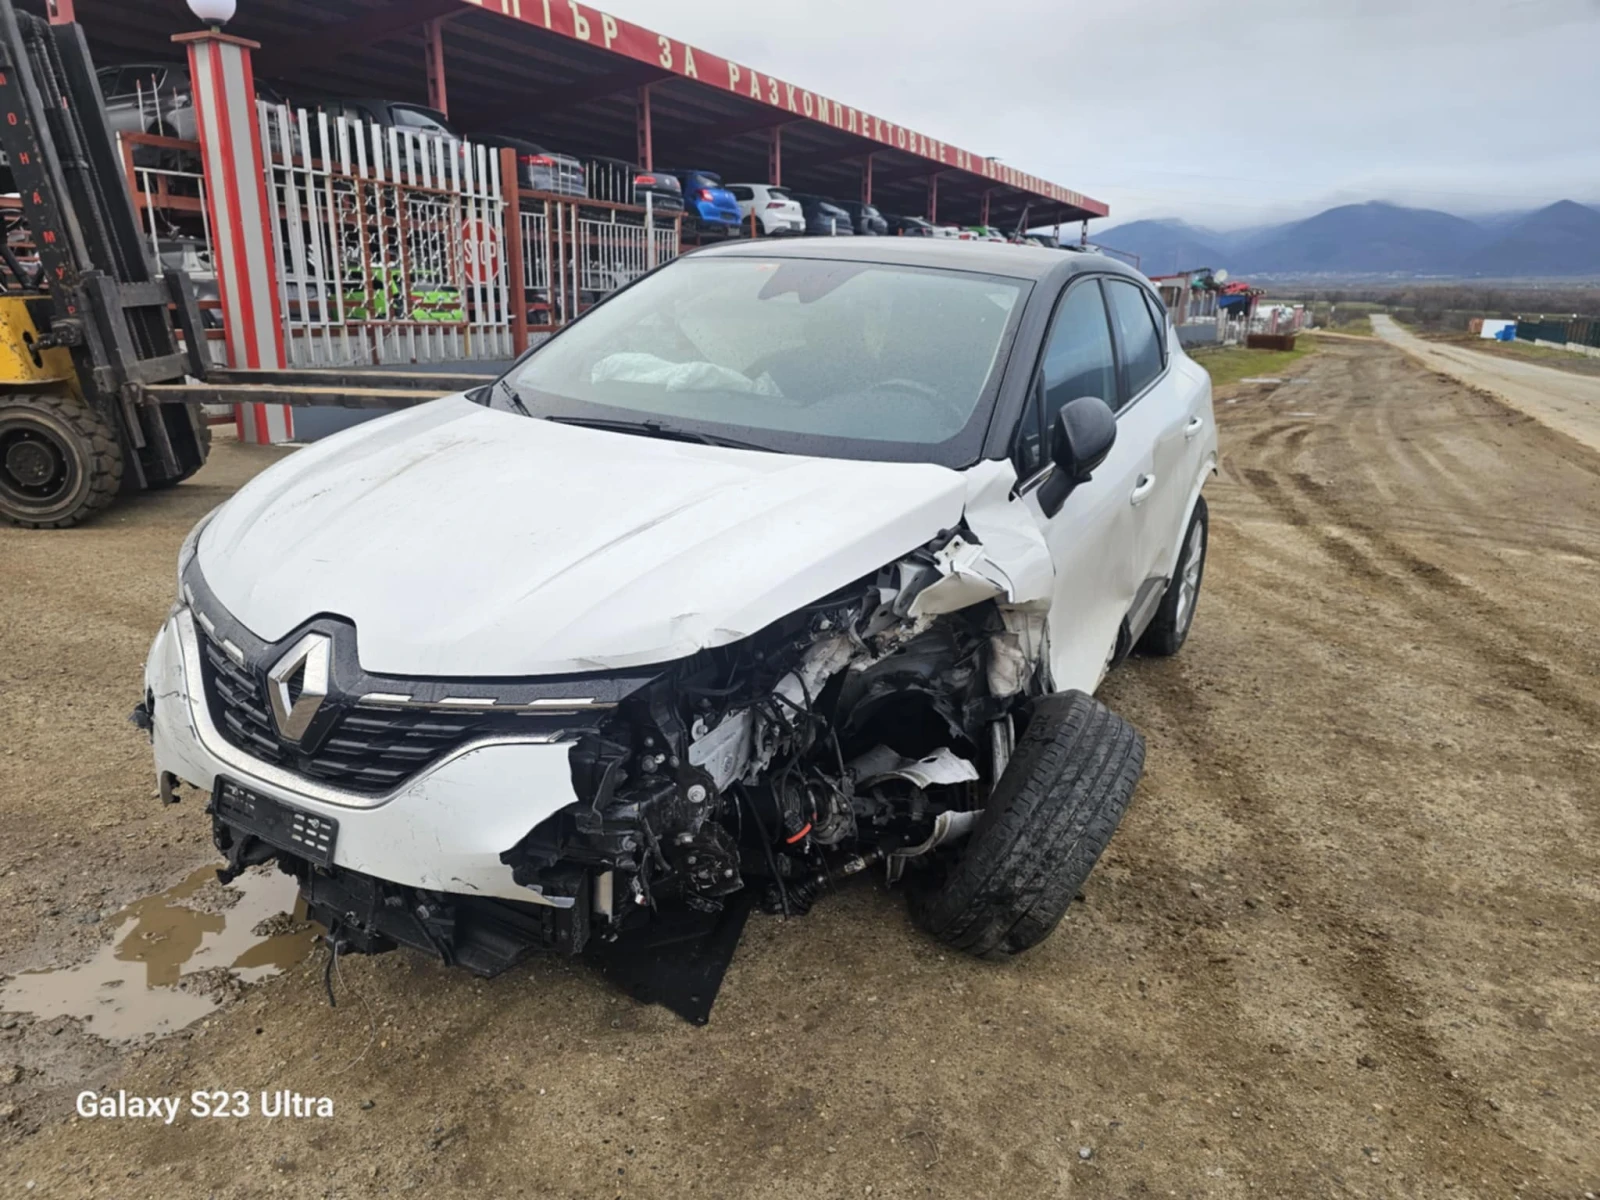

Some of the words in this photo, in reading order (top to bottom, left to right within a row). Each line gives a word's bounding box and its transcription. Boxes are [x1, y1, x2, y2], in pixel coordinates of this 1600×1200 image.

[659, 37, 698, 79] ЗА
[728, 61, 946, 162] РАЗКОМПЛЕКТОВАНЕ
[464, 239, 497, 265] SOP
